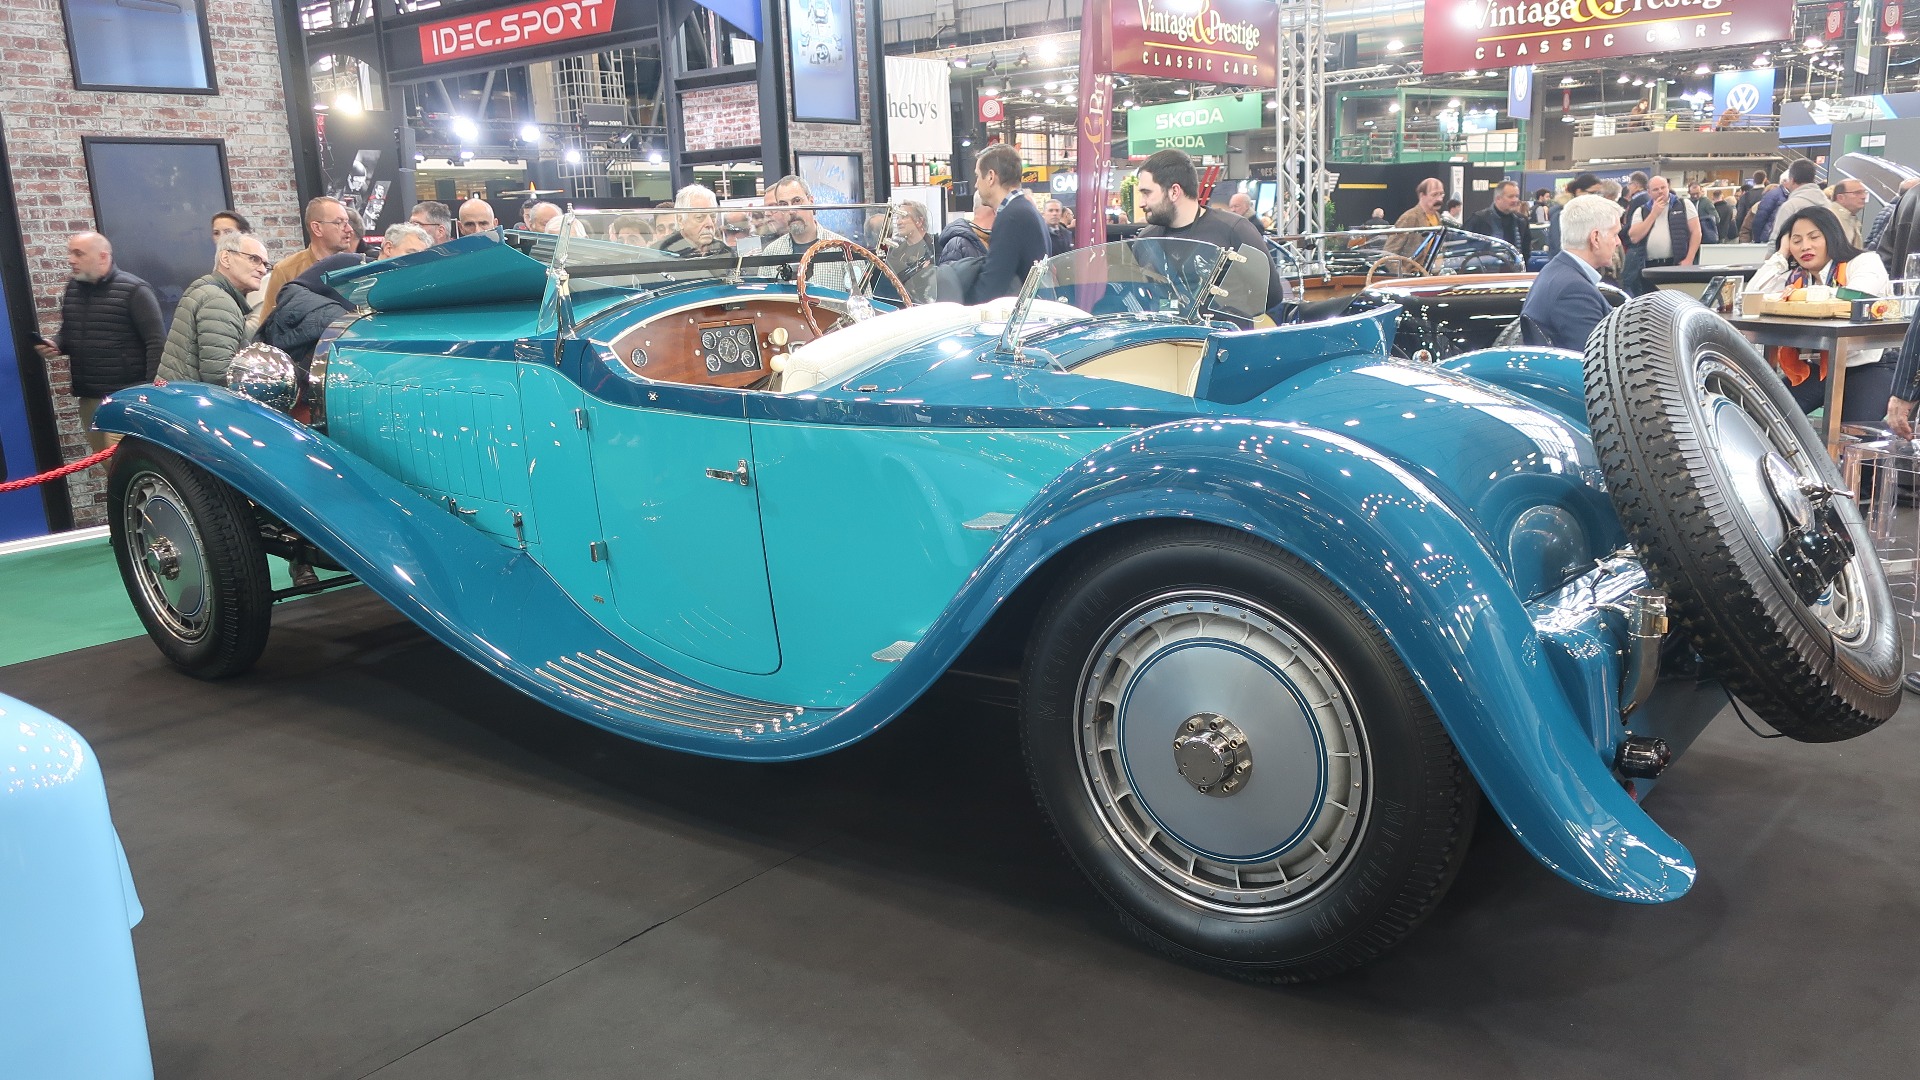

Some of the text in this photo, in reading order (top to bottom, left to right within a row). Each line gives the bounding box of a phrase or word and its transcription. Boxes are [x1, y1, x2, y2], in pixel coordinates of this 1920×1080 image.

[1138, 0, 1194, 42] Vintage
[1210, 9, 1260, 51] Prestige
[1475, 21, 1732, 60] CLASSIC CARS
[1142, 51, 1258, 77] CLASSIC CARS
[887, 93, 938, 124] heby's
[1310, 799, 1407, 940] MICHELIN
